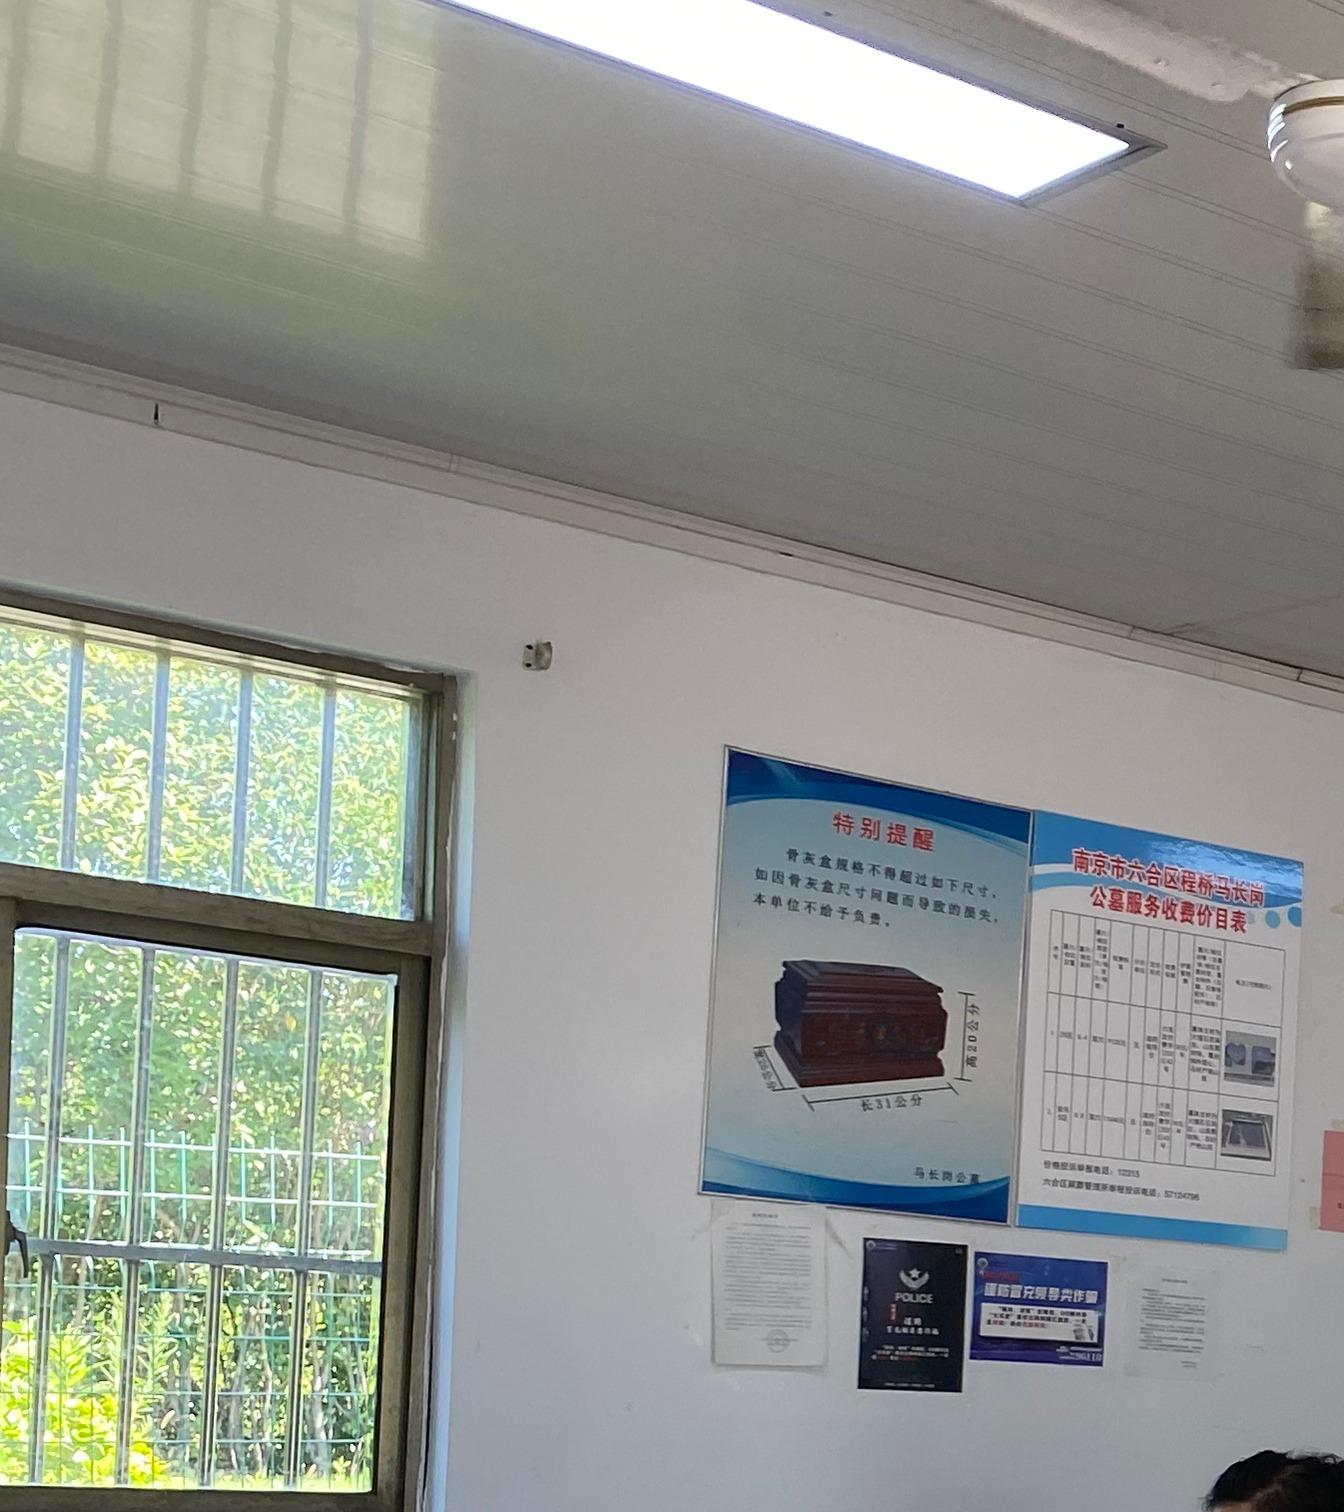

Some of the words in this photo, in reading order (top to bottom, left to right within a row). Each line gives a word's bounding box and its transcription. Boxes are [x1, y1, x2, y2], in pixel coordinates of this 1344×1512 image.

[832, 812, 935, 852] 特别提醒
[1071, 847, 1266, 907] 南京市六合区程桥马长岗
[1089, 885, 1248, 934] 公墓服务收费价目表
[913, 1166, 980, 1184] 马长岗公墓
[895, 1292, 934, 1304] POLICE
